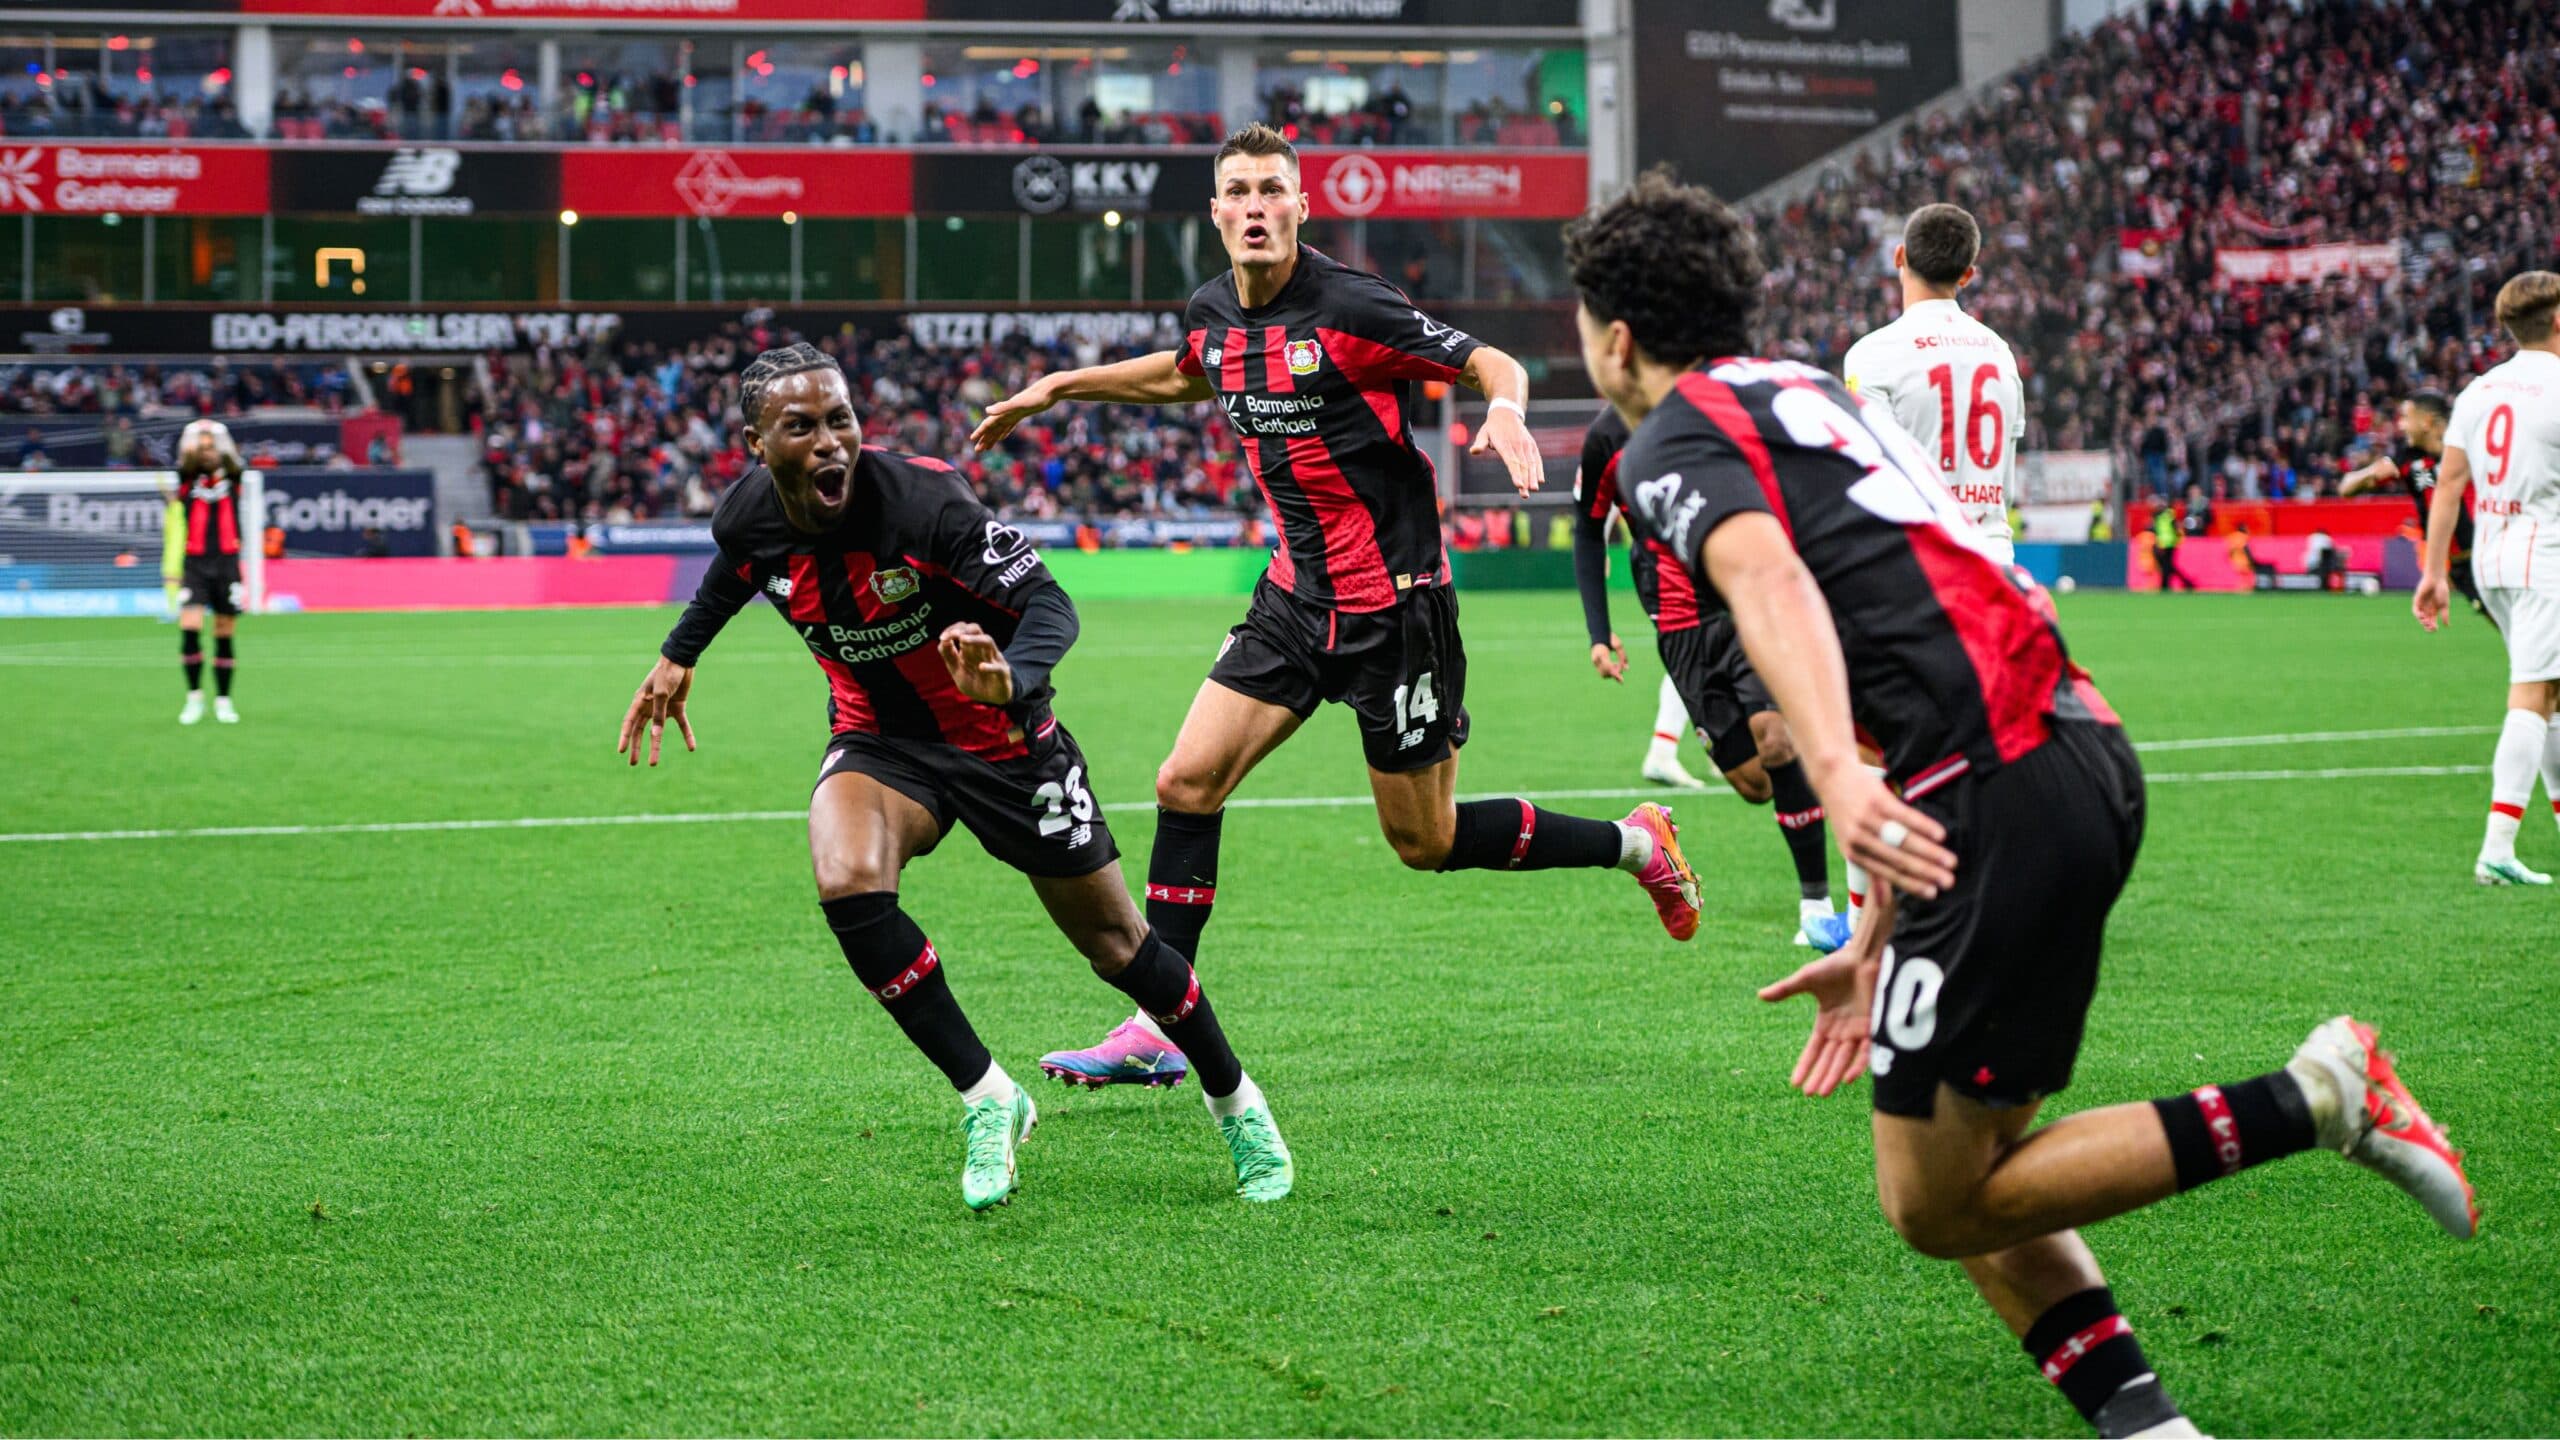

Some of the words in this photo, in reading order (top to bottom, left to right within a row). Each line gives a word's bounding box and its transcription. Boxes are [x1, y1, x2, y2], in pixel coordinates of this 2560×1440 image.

[56, 149, 201, 179] Barmenia
[1072, 161, 1161, 196] KKV
[1393, 165, 1522, 193] NRG24
[55, 180, 180, 210] Gothaer
[1245, 394, 1325, 414] Barmenia
[1927, 362, 2004, 472] 16
[1252, 416, 1317, 434] Gothaer
[2485, 403, 2514, 486] 9
[264, 489, 432, 532] Gothaer
[828, 602, 932, 642] Barmenia
[840, 625, 929, 663] Gothaer
[1394, 671, 1439, 734] 14
[1031, 765, 1093, 837] 23
